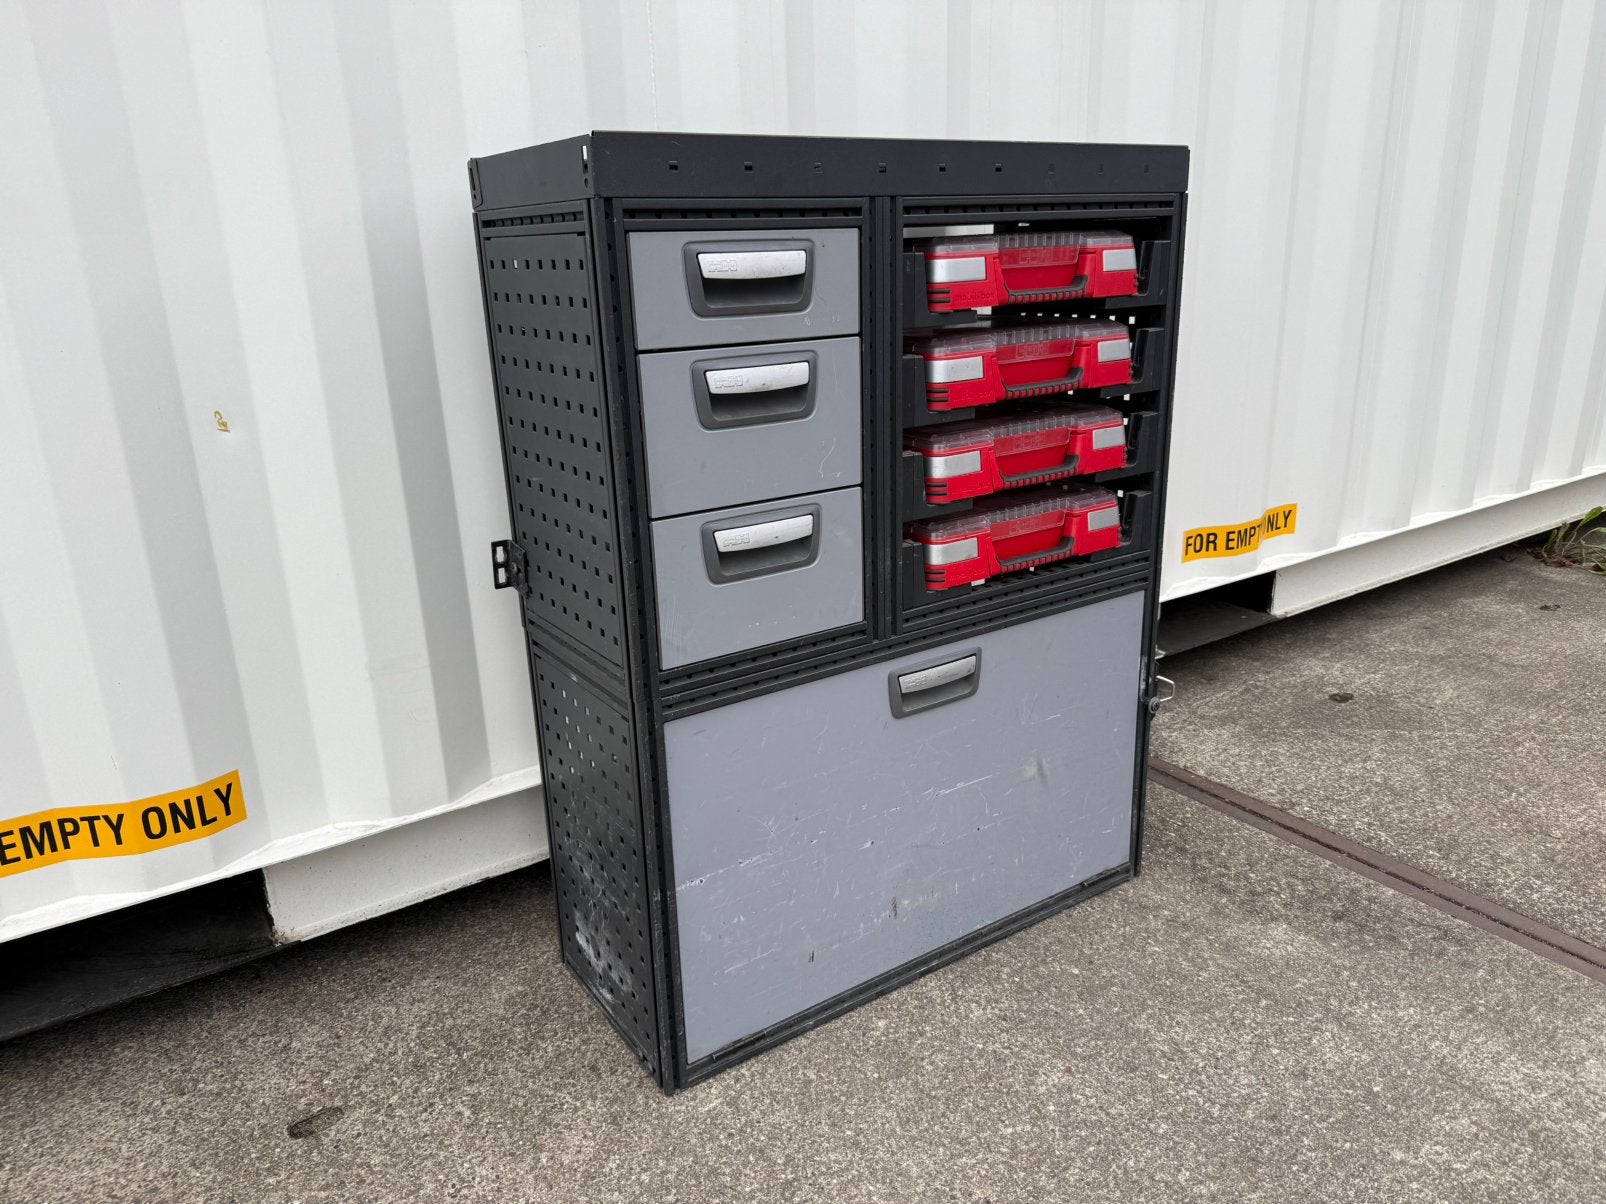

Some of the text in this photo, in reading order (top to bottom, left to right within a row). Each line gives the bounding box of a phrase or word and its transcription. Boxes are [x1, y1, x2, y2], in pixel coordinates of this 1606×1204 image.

[1184, 532, 1218, 556] FOR
[1225, 523, 1262, 551] EMPT
[0, 782, 233, 866] EMPTY ONLY
